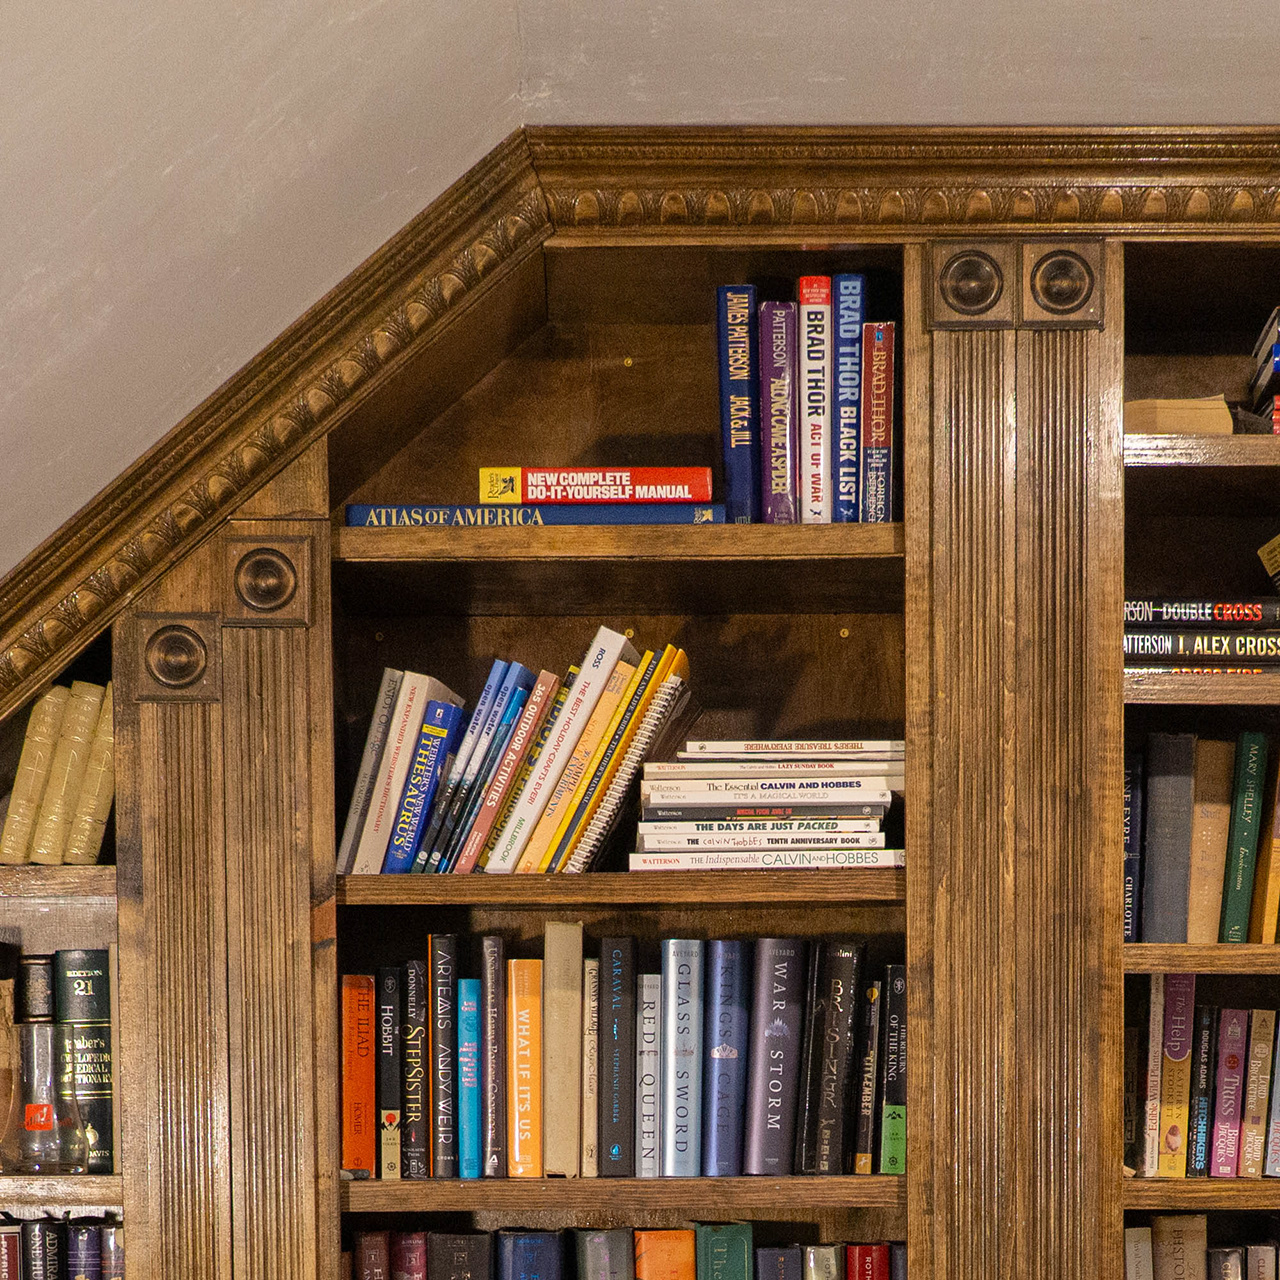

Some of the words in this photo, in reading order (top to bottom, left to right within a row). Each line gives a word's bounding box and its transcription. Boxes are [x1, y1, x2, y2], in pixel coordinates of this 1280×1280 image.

[727, 292, 748, 324] JAMES
[839, 281, 861, 338] BRAD
[807, 310, 825, 361] BRAD
[728, 326, 750, 380] PATTERSON
[838, 343, 860, 401] THOR
[730, 394, 749, 418] JACK
[807, 366, 825, 417] THOR
[731, 429, 749, 448] JILL
[732, 420, 746, 429] &
[810, 423, 822, 447] ACT
[839, 406, 856, 462] BLACK
[810, 453, 822, 467] OF
[527, 473, 557, 486] NEW
[561, 472, 631, 486] COMPLETE
[527, 486, 633, 499] DO-IT-YOURSELF
[635, 486, 692, 498] MANUAL
[811, 473, 823, 503] WAR
[839, 467, 855, 503] LIST
[365, 508, 423, 526] ATLAS
[425, 509, 450, 526] OF
[452, 508, 544, 526] AMERICA
[1162, 603, 1213, 620] DOUBLE
[1213, 603, 1263, 622] CROSS
[531, 683, 547, 703] 365
[510, 705, 538, 750] OUTDOOR
[1246, 744, 1259, 776] MARY
[485, 751, 517, 808] ACTIVITIES
[1241, 779, 1255, 823] SHELLEY
[695, 823, 716, 831] THE
[717, 823, 746, 831] DAYS
[748, 822, 767, 831] ARE
[770, 822, 794, 831] JUST
[797, 822, 839, 830] PACKED
[705, 854, 760, 864] Indispensable
[762, 853, 812, 866] CALVIN
[812, 855, 827, 863] AND
[826, 851, 879, 864] HOBBES
[436, 950, 451, 1029] ARTEMIS
[677, 963, 692, 1036] GLASS
[518, 1009, 531, 1061] WHAT
[642, 1001, 658, 1044] RED
[437, 1044, 452, 1093] ANDY
[519, 1064, 531, 1079] IF
[519, 1085, 531, 1110] IT'S
[675, 1071, 690, 1153] SWORD
[437, 1098, 454, 1144] WEIR
[519, 1119, 530, 1140] US
[640, 1073, 656, 1159] QUEEN
